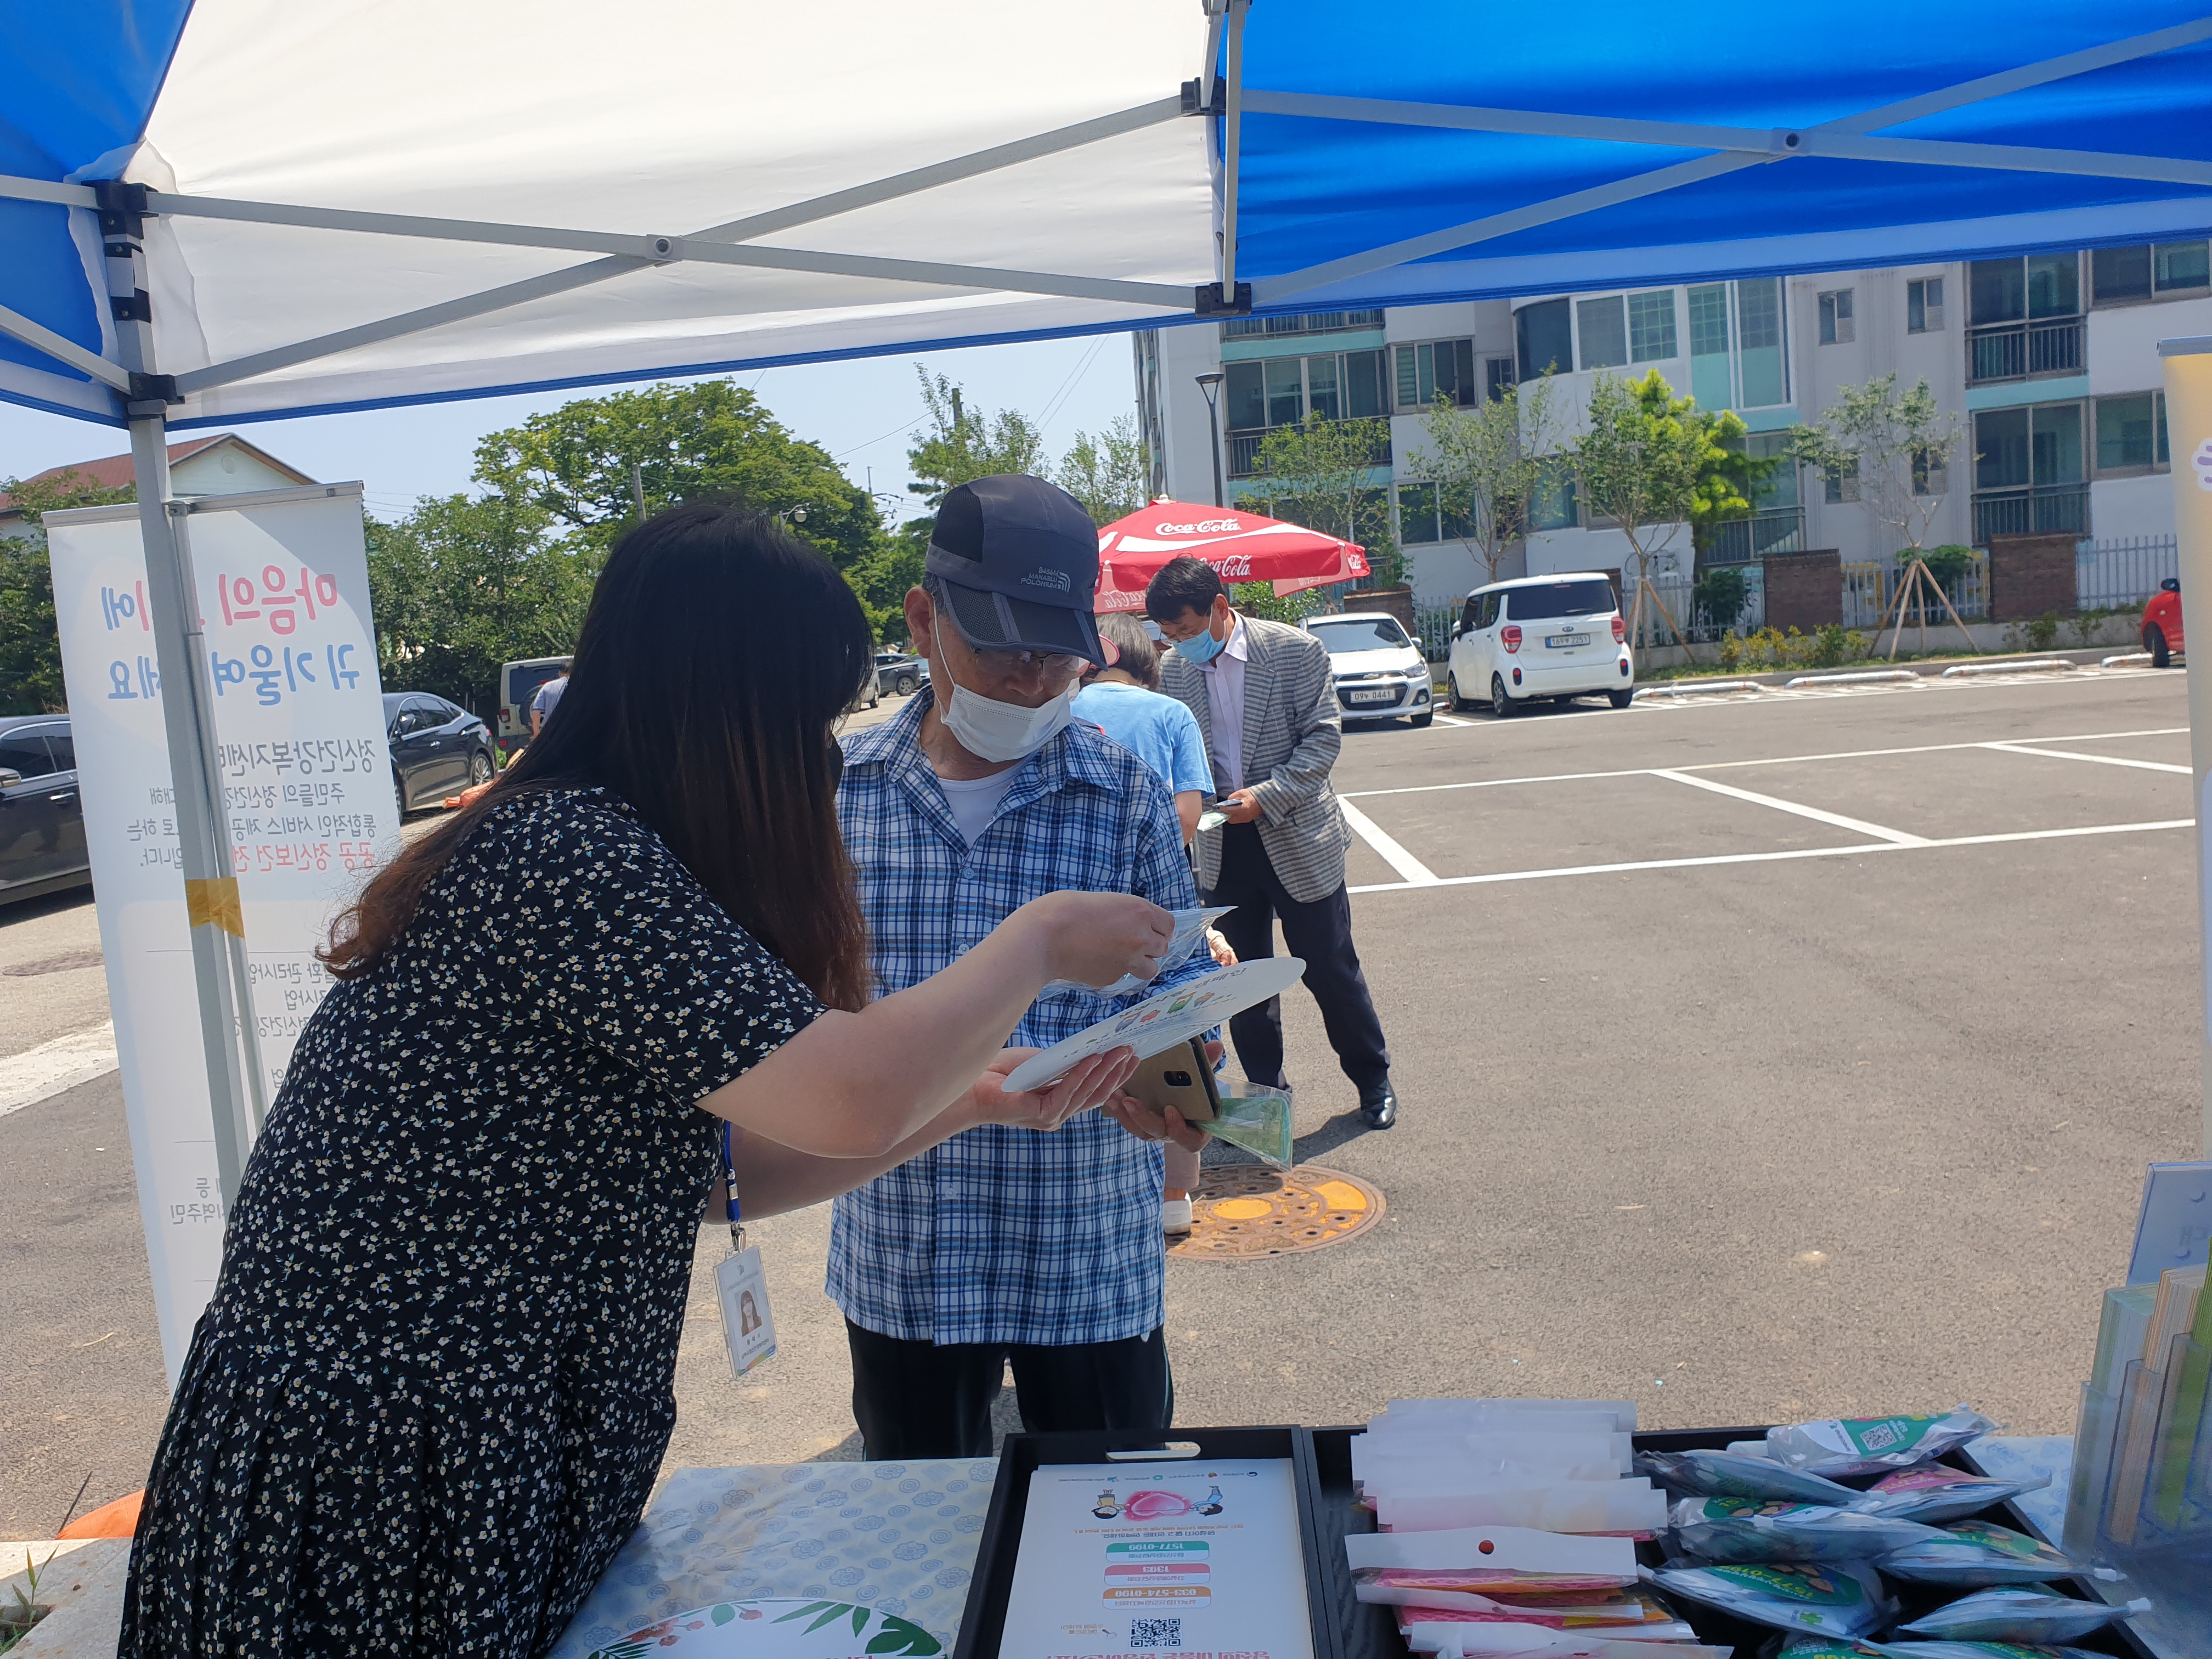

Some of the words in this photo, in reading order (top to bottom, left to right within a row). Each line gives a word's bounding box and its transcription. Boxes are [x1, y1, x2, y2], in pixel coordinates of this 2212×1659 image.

[1155, 518, 1241, 535] Coca-Cola
[1200, 555, 1252, 577] ca-Cola
[1020, 578, 1057, 589] POLONIUM
[1029, 573, 1058, 582] MANASLU
